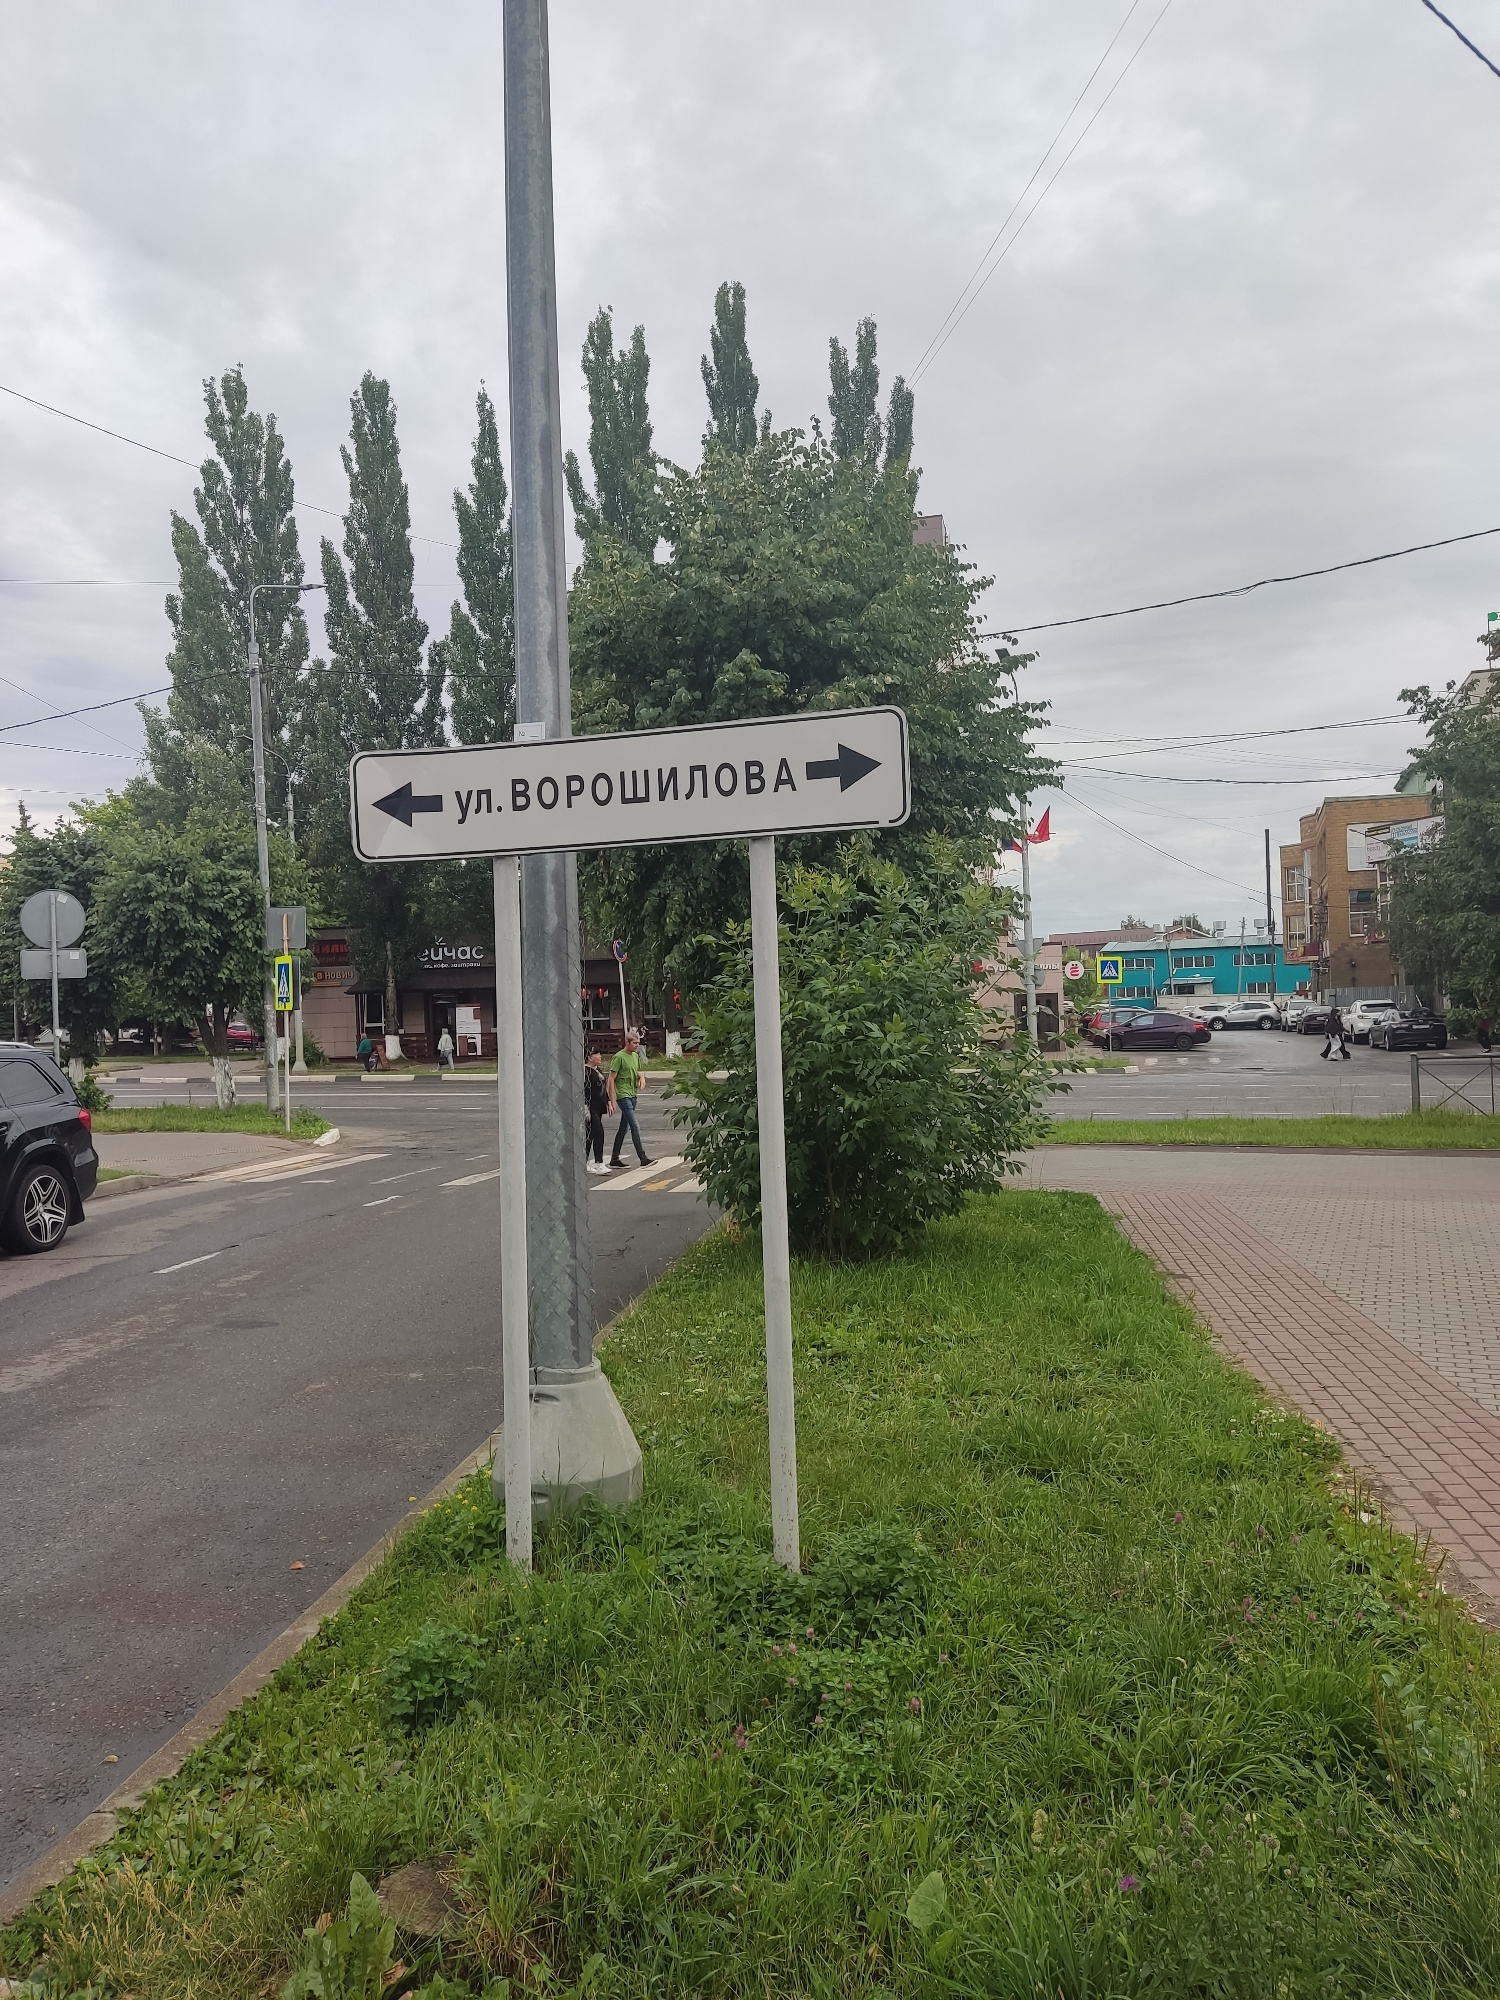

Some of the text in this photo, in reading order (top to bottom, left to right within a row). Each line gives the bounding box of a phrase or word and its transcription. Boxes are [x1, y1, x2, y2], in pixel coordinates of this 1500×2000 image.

[454, 757, 797, 825] ул. ВОРОШИЛОВА
[418, 935, 485, 962] ейчас
